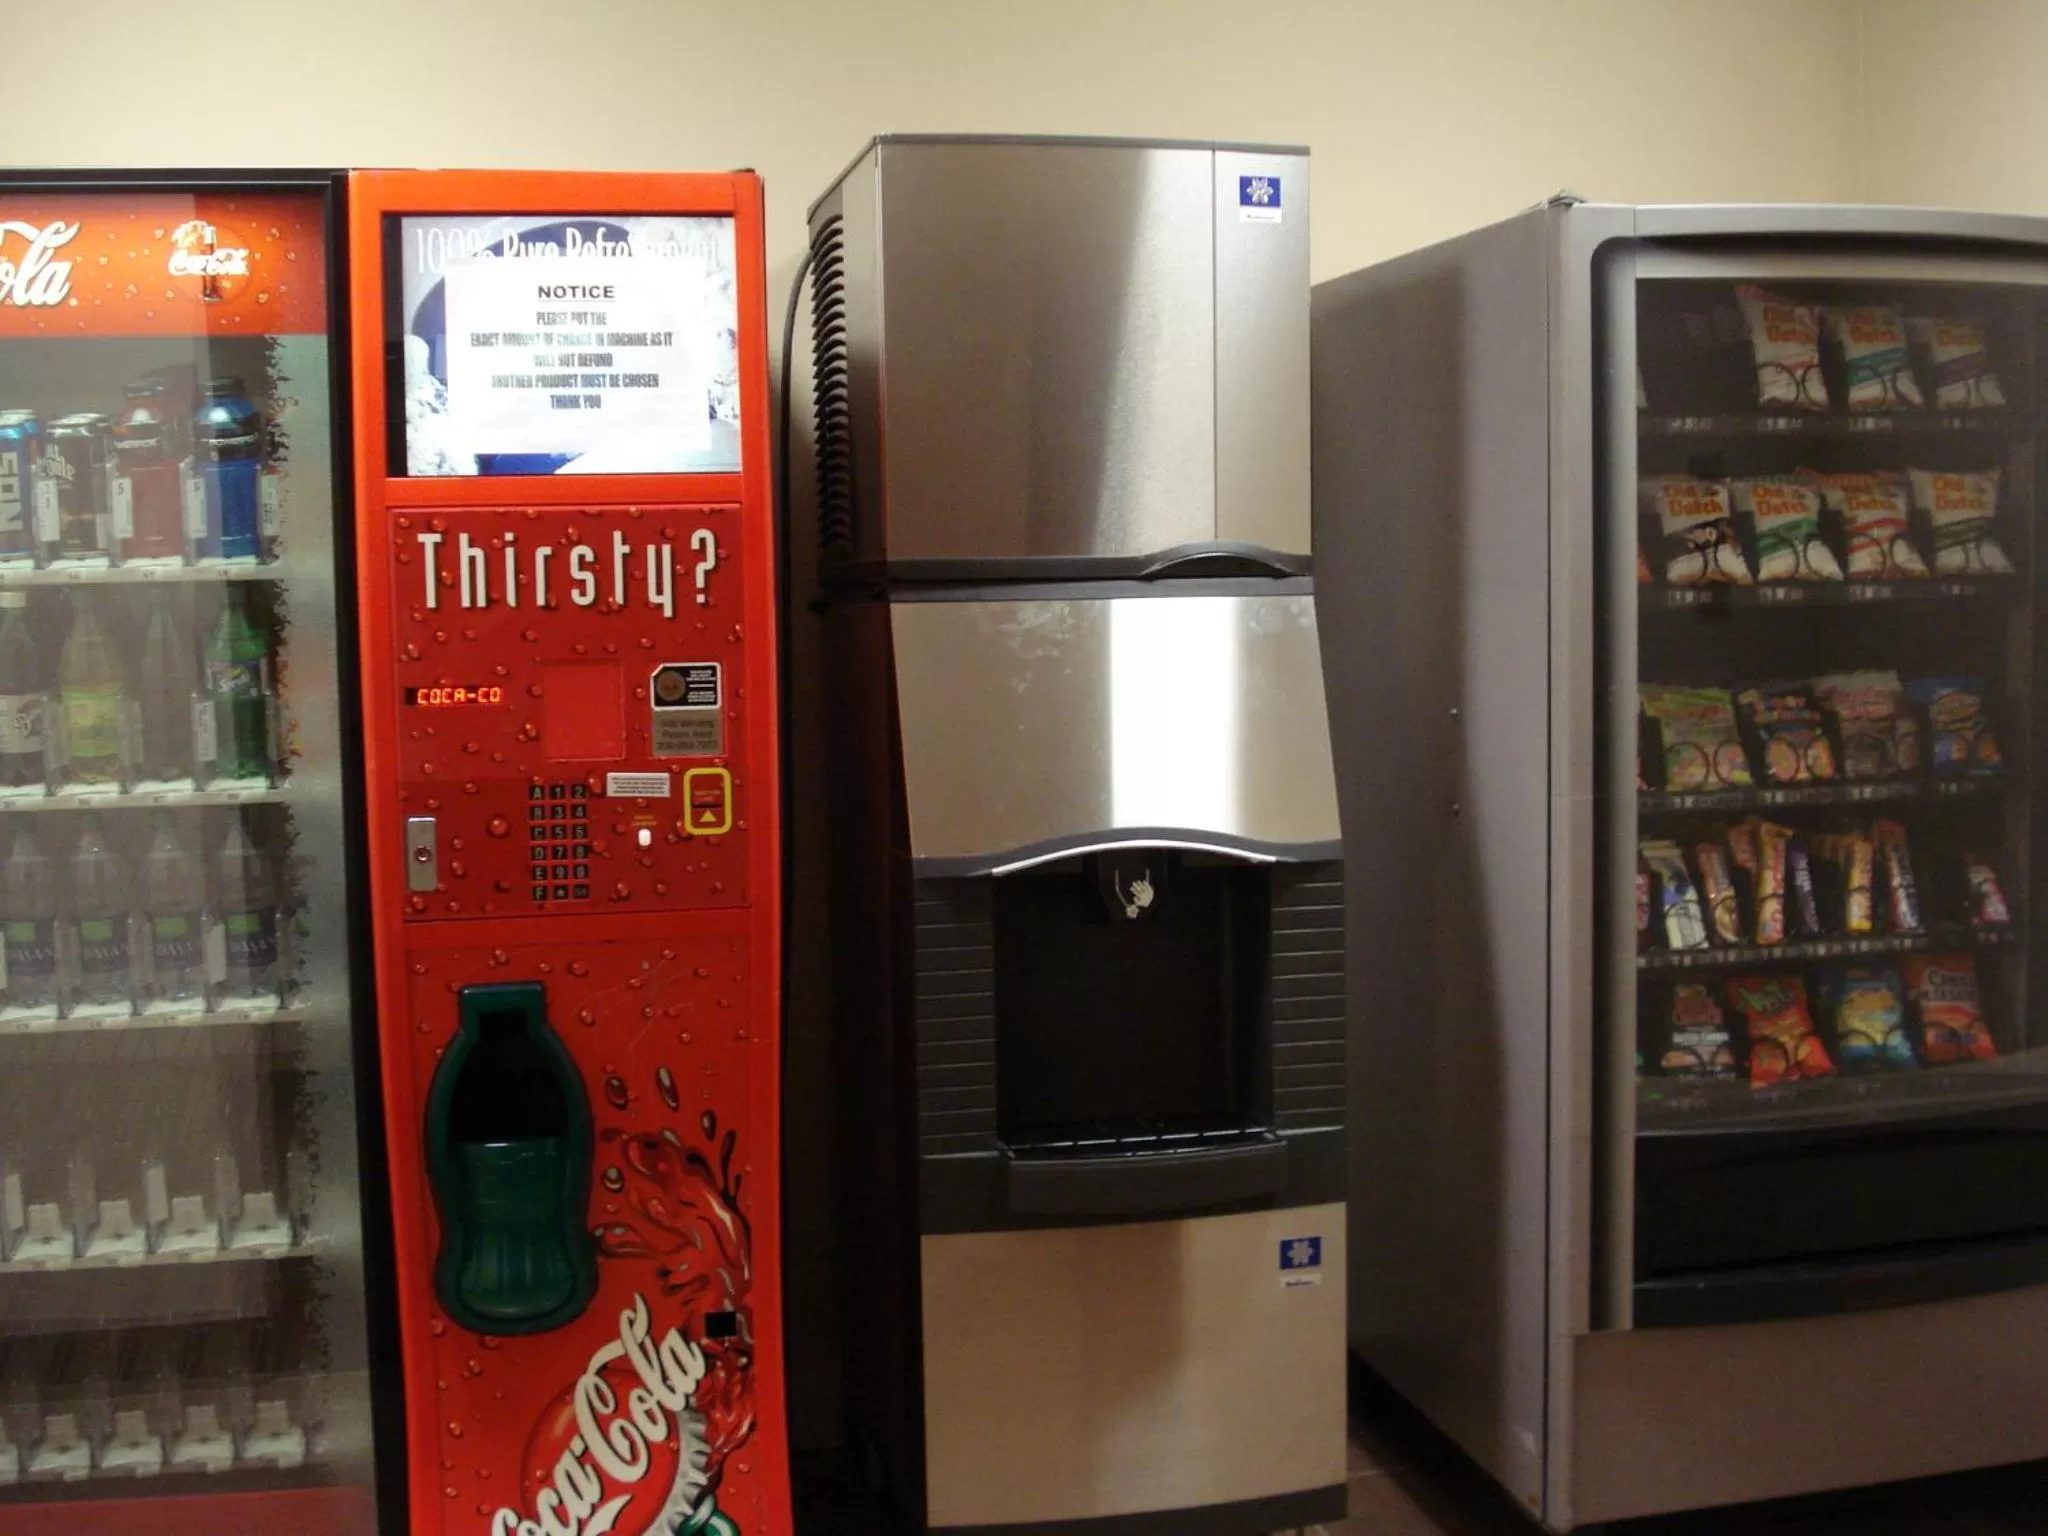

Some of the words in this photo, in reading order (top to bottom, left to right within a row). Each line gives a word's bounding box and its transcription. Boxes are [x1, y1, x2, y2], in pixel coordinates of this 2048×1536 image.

[0, 220, 80, 306] ola
[538, 285, 615, 299] NOTICE
[536, 311, 568, 325] PLEASE
[571, 311, 588, 325] PUT
[590, 311, 607, 325] THE
[650, 332, 662, 346] AS
[663, 332, 673, 346] IT
[558, 353, 576, 367] NOT
[578, 353, 613, 367] REFUND
[535, 374, 579, 389] PRODUCT
[580, 373, 607, 389] MUST
[609, 374, 621, 388] BE
[622, 373, 659, 388] CHOSEN
[550, 395, 581, 409] THANK
[583, 395, 602, 409] YOU
[416, 528, 717, 619] Thirsty?
[417, 686, 501, 704] COCA-CO
[533, 786, 543, 800] A
[554, 786, 562, 799] 1
[574, 785, 584, 799] 2
[555, 806, 565, 819] 3
[576, 806, 585, 819] 4
[555, 827, 565, 839] 5
[556, 846, 564, 860] 7
